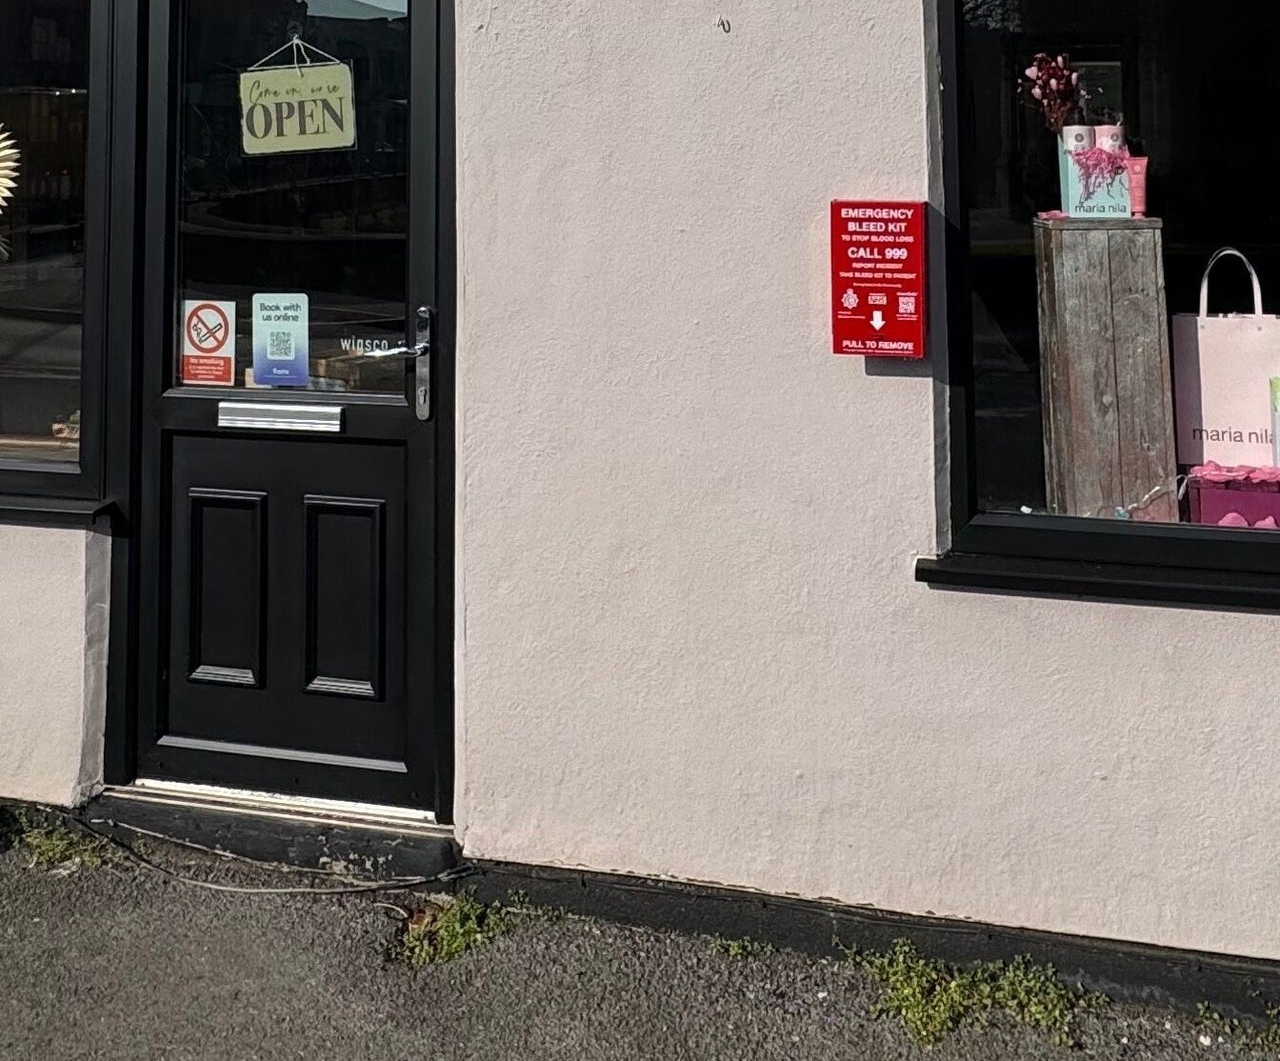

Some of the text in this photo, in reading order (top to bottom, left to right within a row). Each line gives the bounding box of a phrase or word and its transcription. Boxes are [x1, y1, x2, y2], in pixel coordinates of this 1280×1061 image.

[245, 97, 345, 139] OPEN
[841, 207, 914, 219] EMERGENCY
[1074, 203, 1106, 213] maria
[847, 221, 908, 232] BLEED KIT
[847, 246, 908, 260] CALL 999
[259, 302, 302, 312] Book with
[261, 313, 273, 322] us
[842, 339, 865, 349] PULL
[865, 340, 878, 350] TO
[878, 340, 914, 351] REMOVE
[1192, 426, 1244, 443] maria
